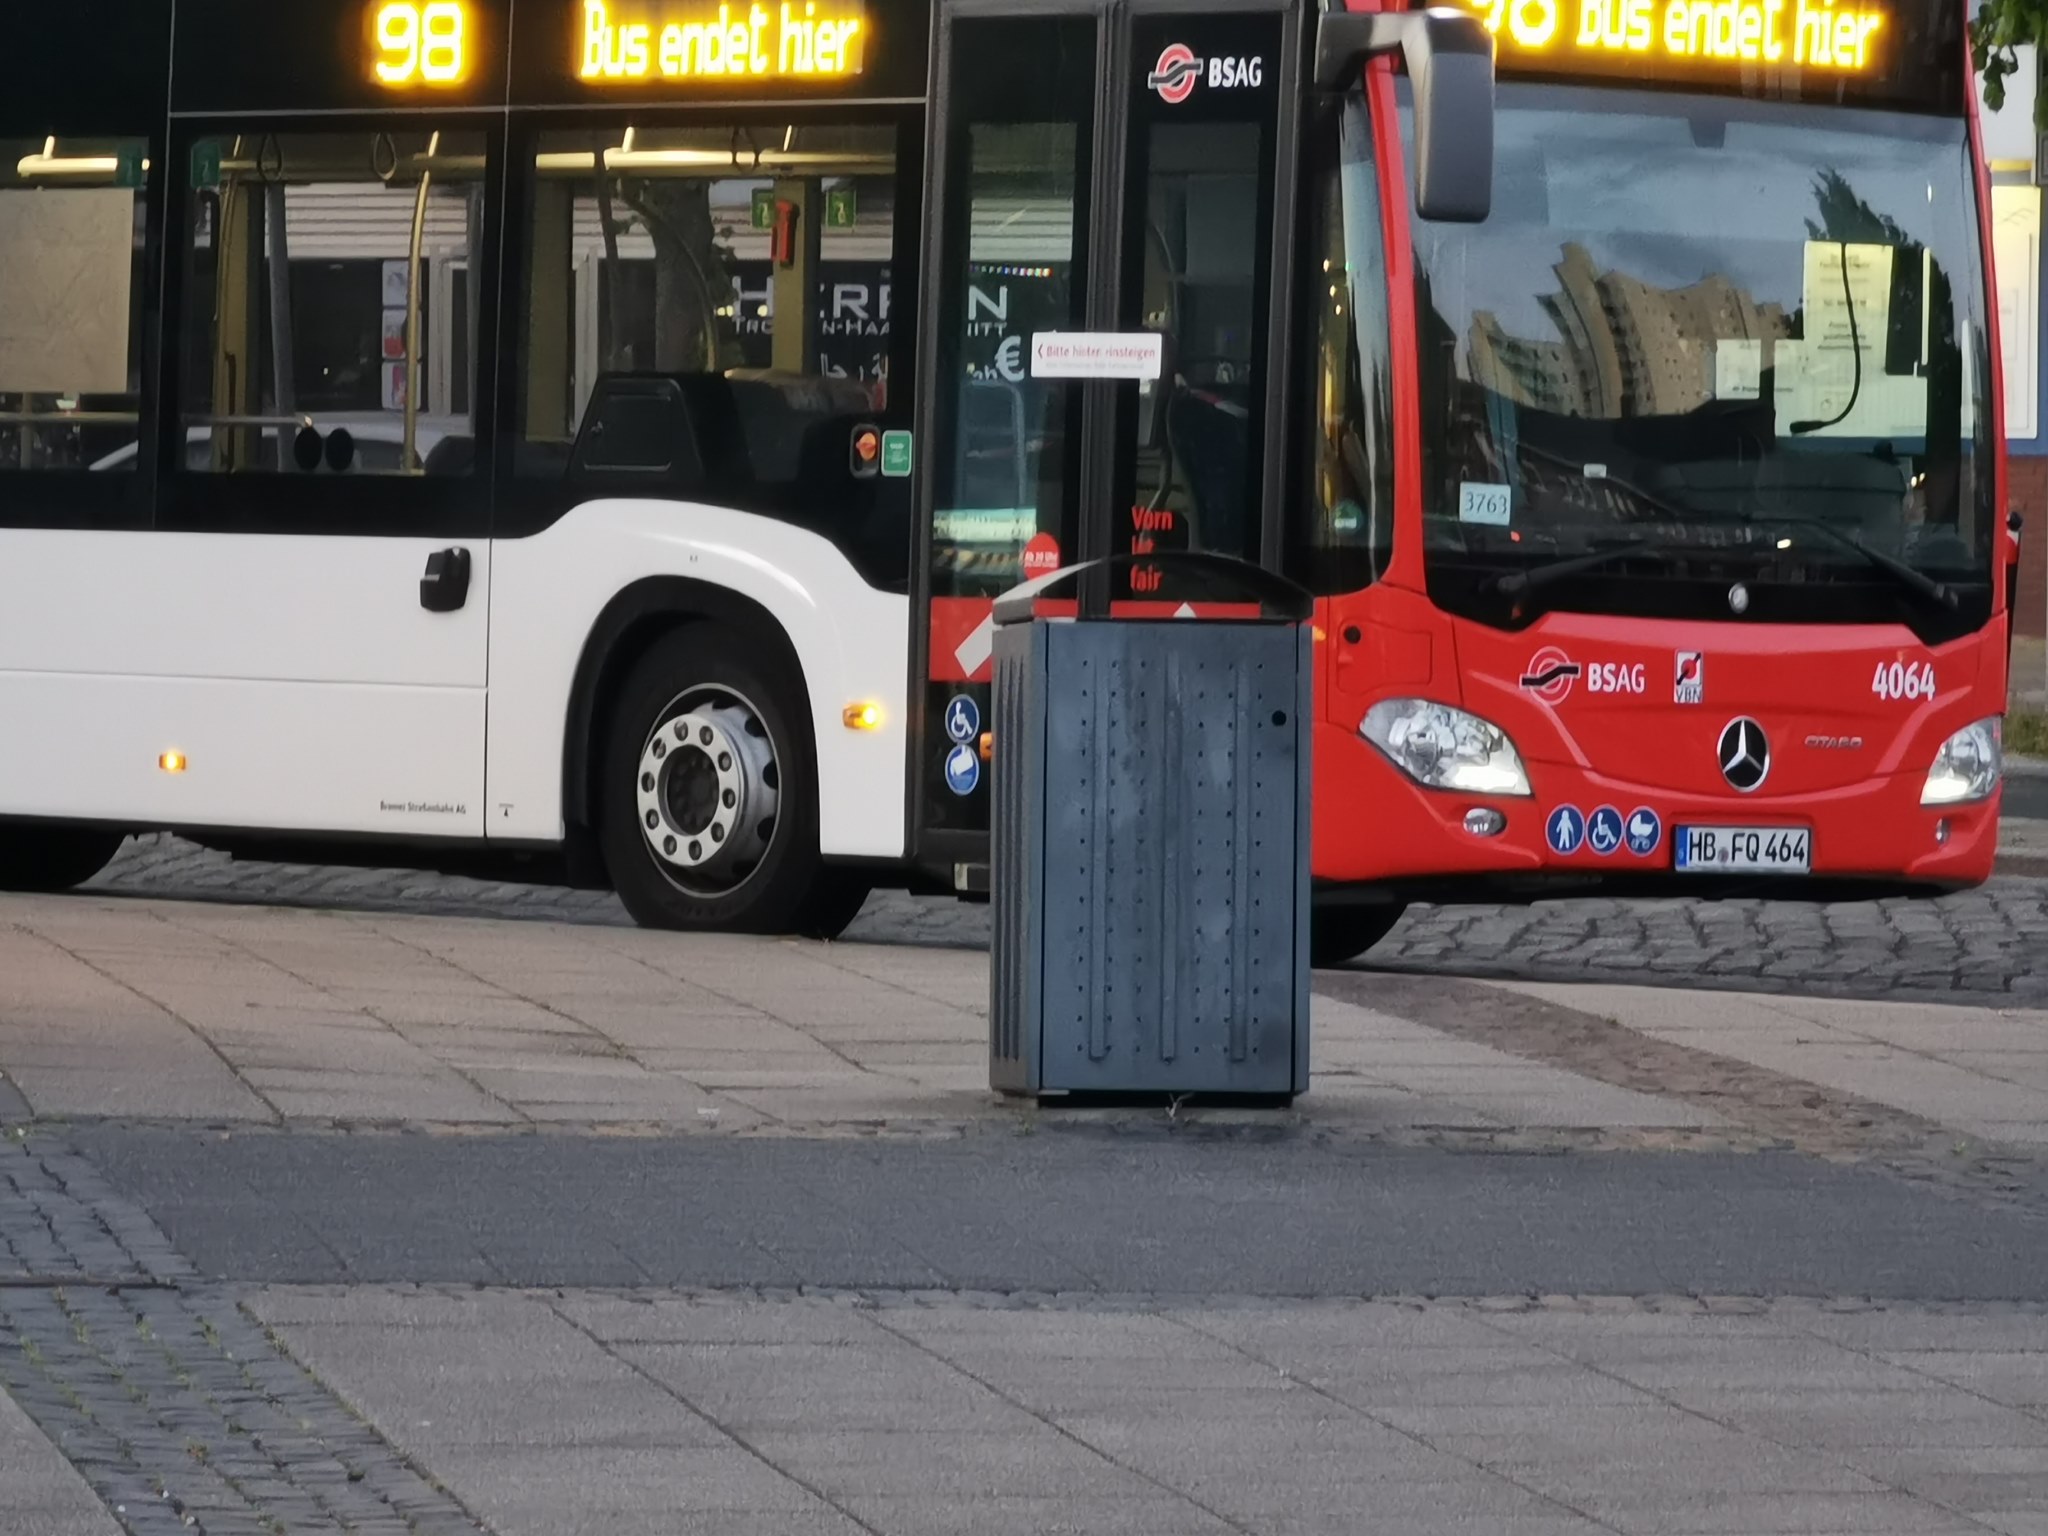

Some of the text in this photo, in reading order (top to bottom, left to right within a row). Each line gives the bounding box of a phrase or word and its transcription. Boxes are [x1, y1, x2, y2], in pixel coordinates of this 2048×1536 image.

[376, 1, 466, 81] 98
[579, 0, 859, 77] Bus endet hier
[1664, 0, 1782, 62] endet
[1793, 0, 1879, 70] hier
[1208, 56, 1262, 88] BSAG
[1131, 505, 1173, 531] Vorn
[1464, 491, 1508, 515] 3763
[1130, 563, 1163, 592] fair
[1587, 662, 1646, 694] BSAG
[1872, 661, 1936, 701] 4064
[1689, 831, 1805, 863] HB FQ 464
